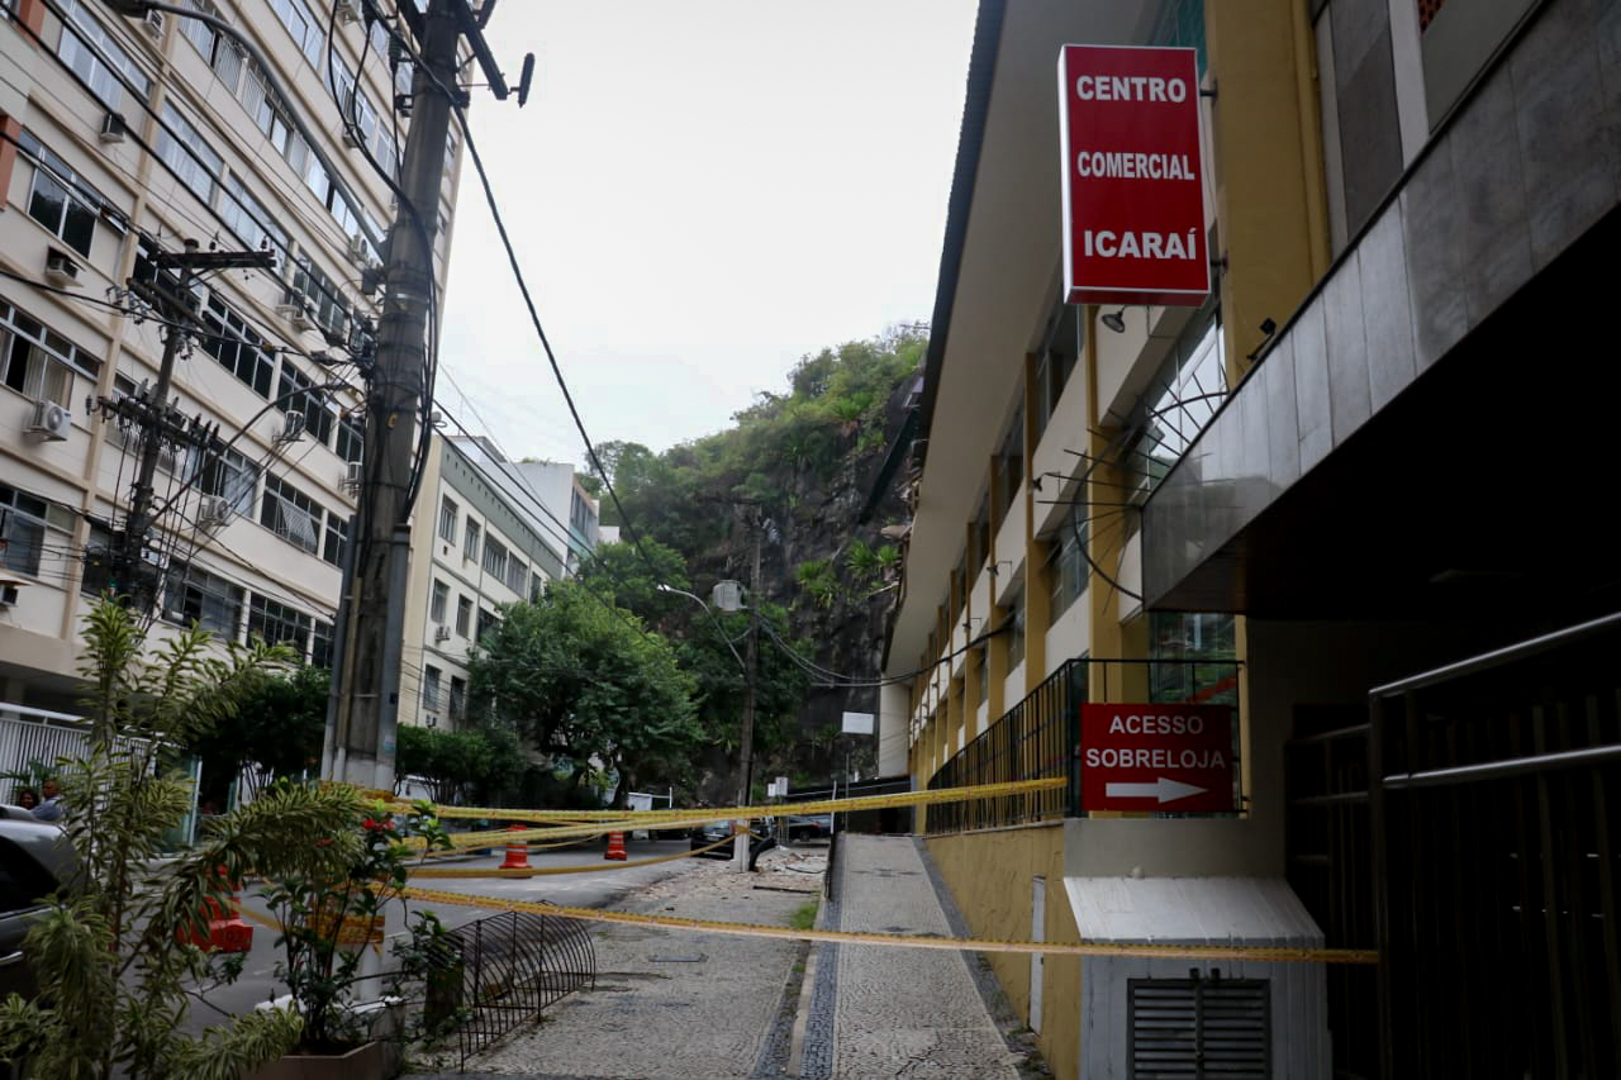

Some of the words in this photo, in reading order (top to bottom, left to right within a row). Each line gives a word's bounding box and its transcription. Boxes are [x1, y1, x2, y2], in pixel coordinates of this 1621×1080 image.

[1076, 75, 1186, 103] CENTRO
[1077, 151, 1195, 180] COMERCIAL
[1083, 228, 1197, 260] ICARAÍ
[1109, 715, 1203, 734] ACESSO
[1086, 748, 1225, 768] SOBRELOJA
